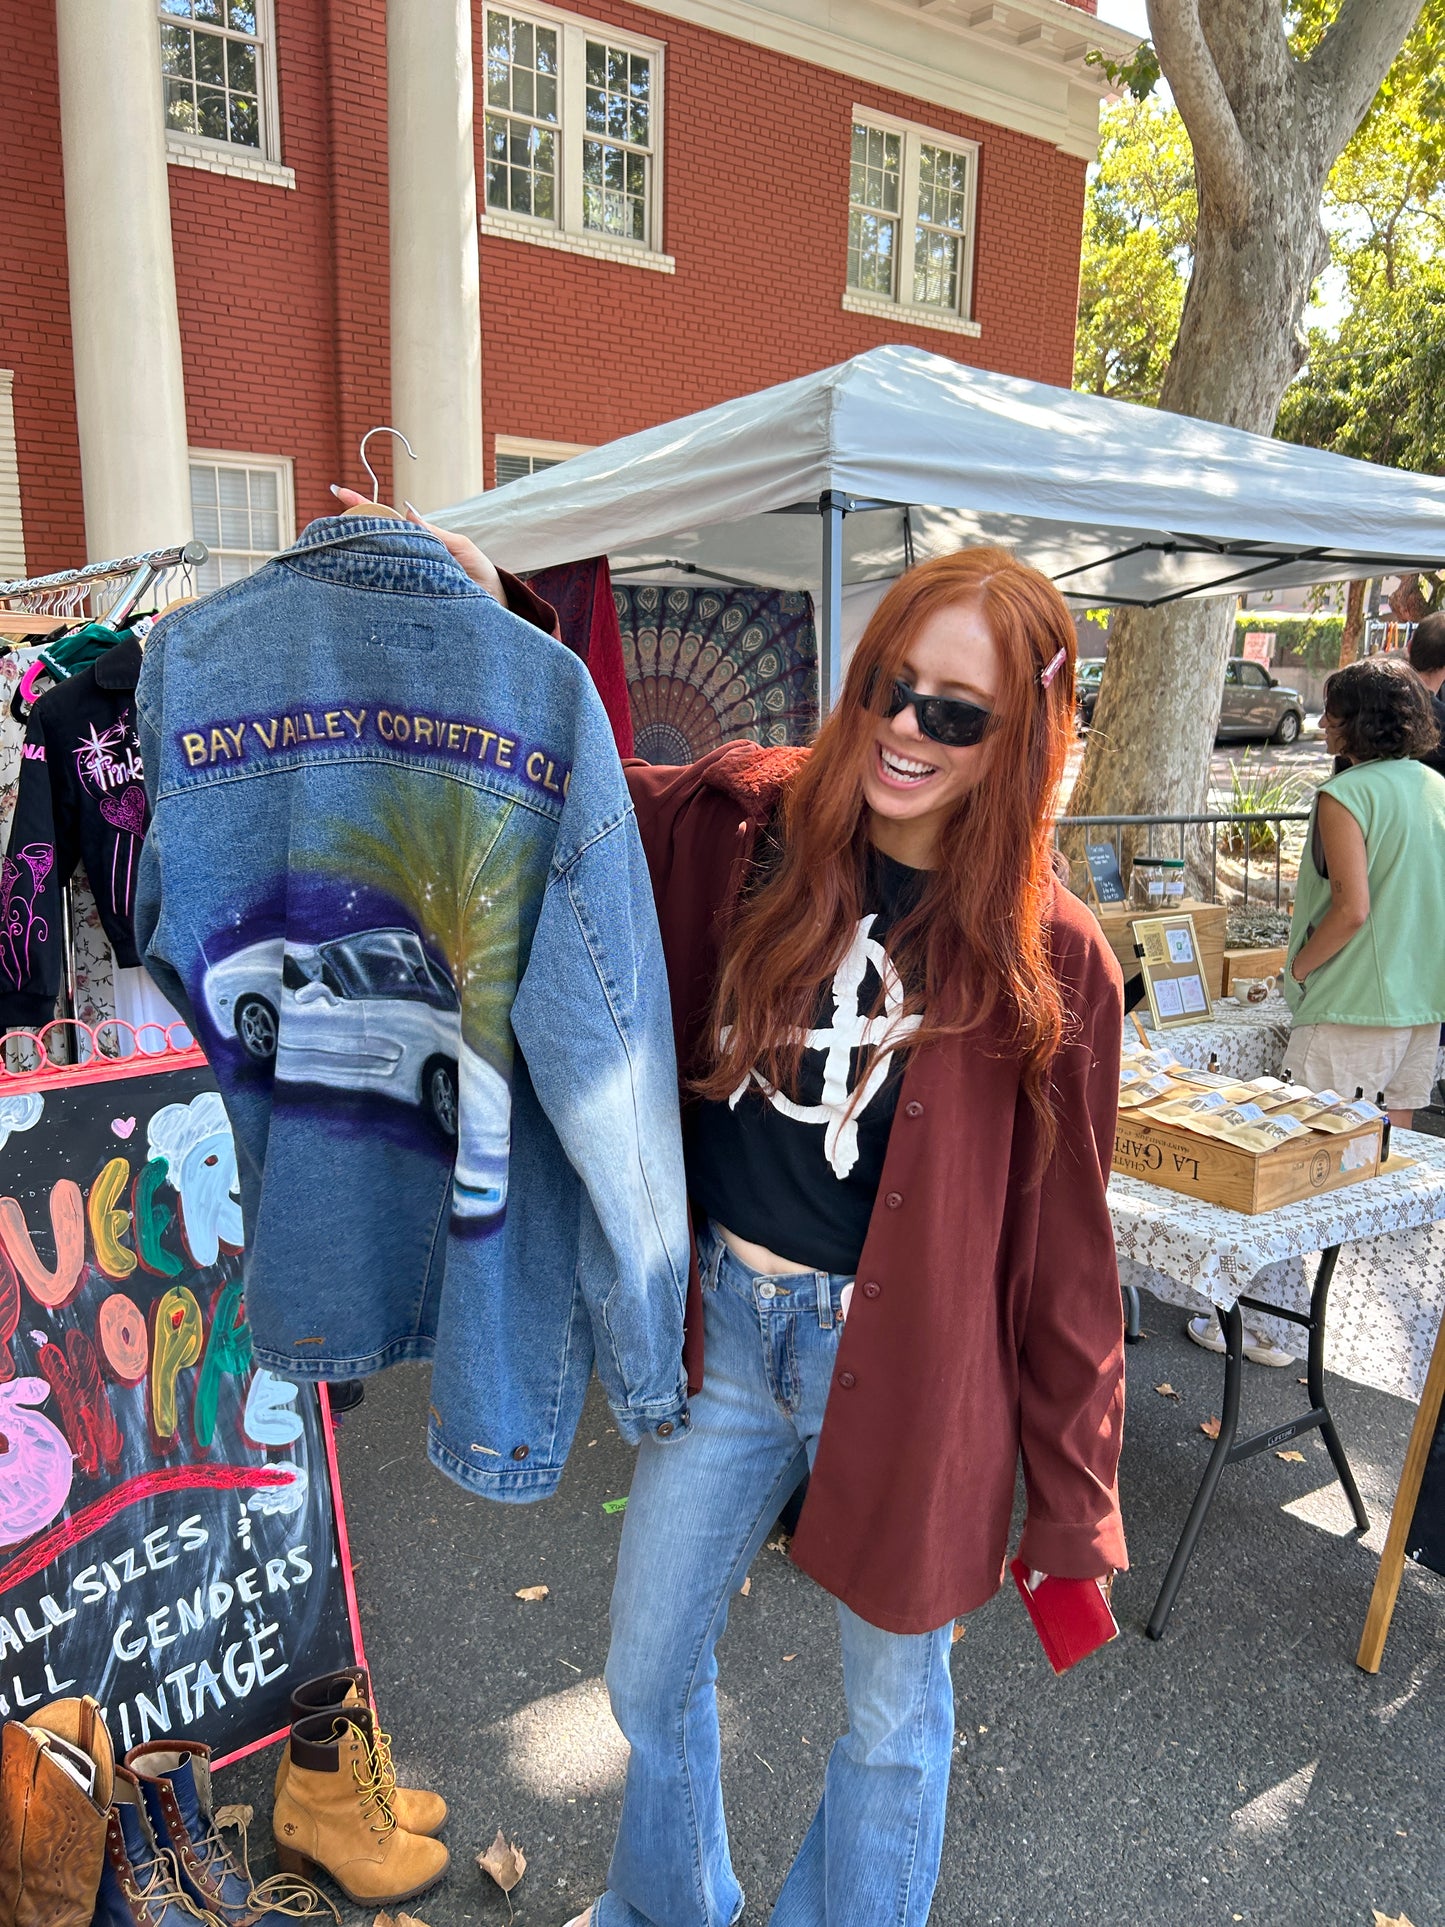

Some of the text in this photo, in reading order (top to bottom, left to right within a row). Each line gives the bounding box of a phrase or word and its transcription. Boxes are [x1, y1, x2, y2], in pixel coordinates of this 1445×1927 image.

[182, 722, 246, 767] BAY
[252, 708, 367, 749] VALLEY
[376, 709, 516, 769] CORVETTE
[1173, 1152, 1201, 1181] LA
[0, 1132, 244, 1382] UEER
[0, 1594, 77, 1661] ALL
[73, 1514, 209, 1604] SIZES
[113, 1545, 313, 1662] GENDERS
[99, 1622, 289, 1752] INTAGE
